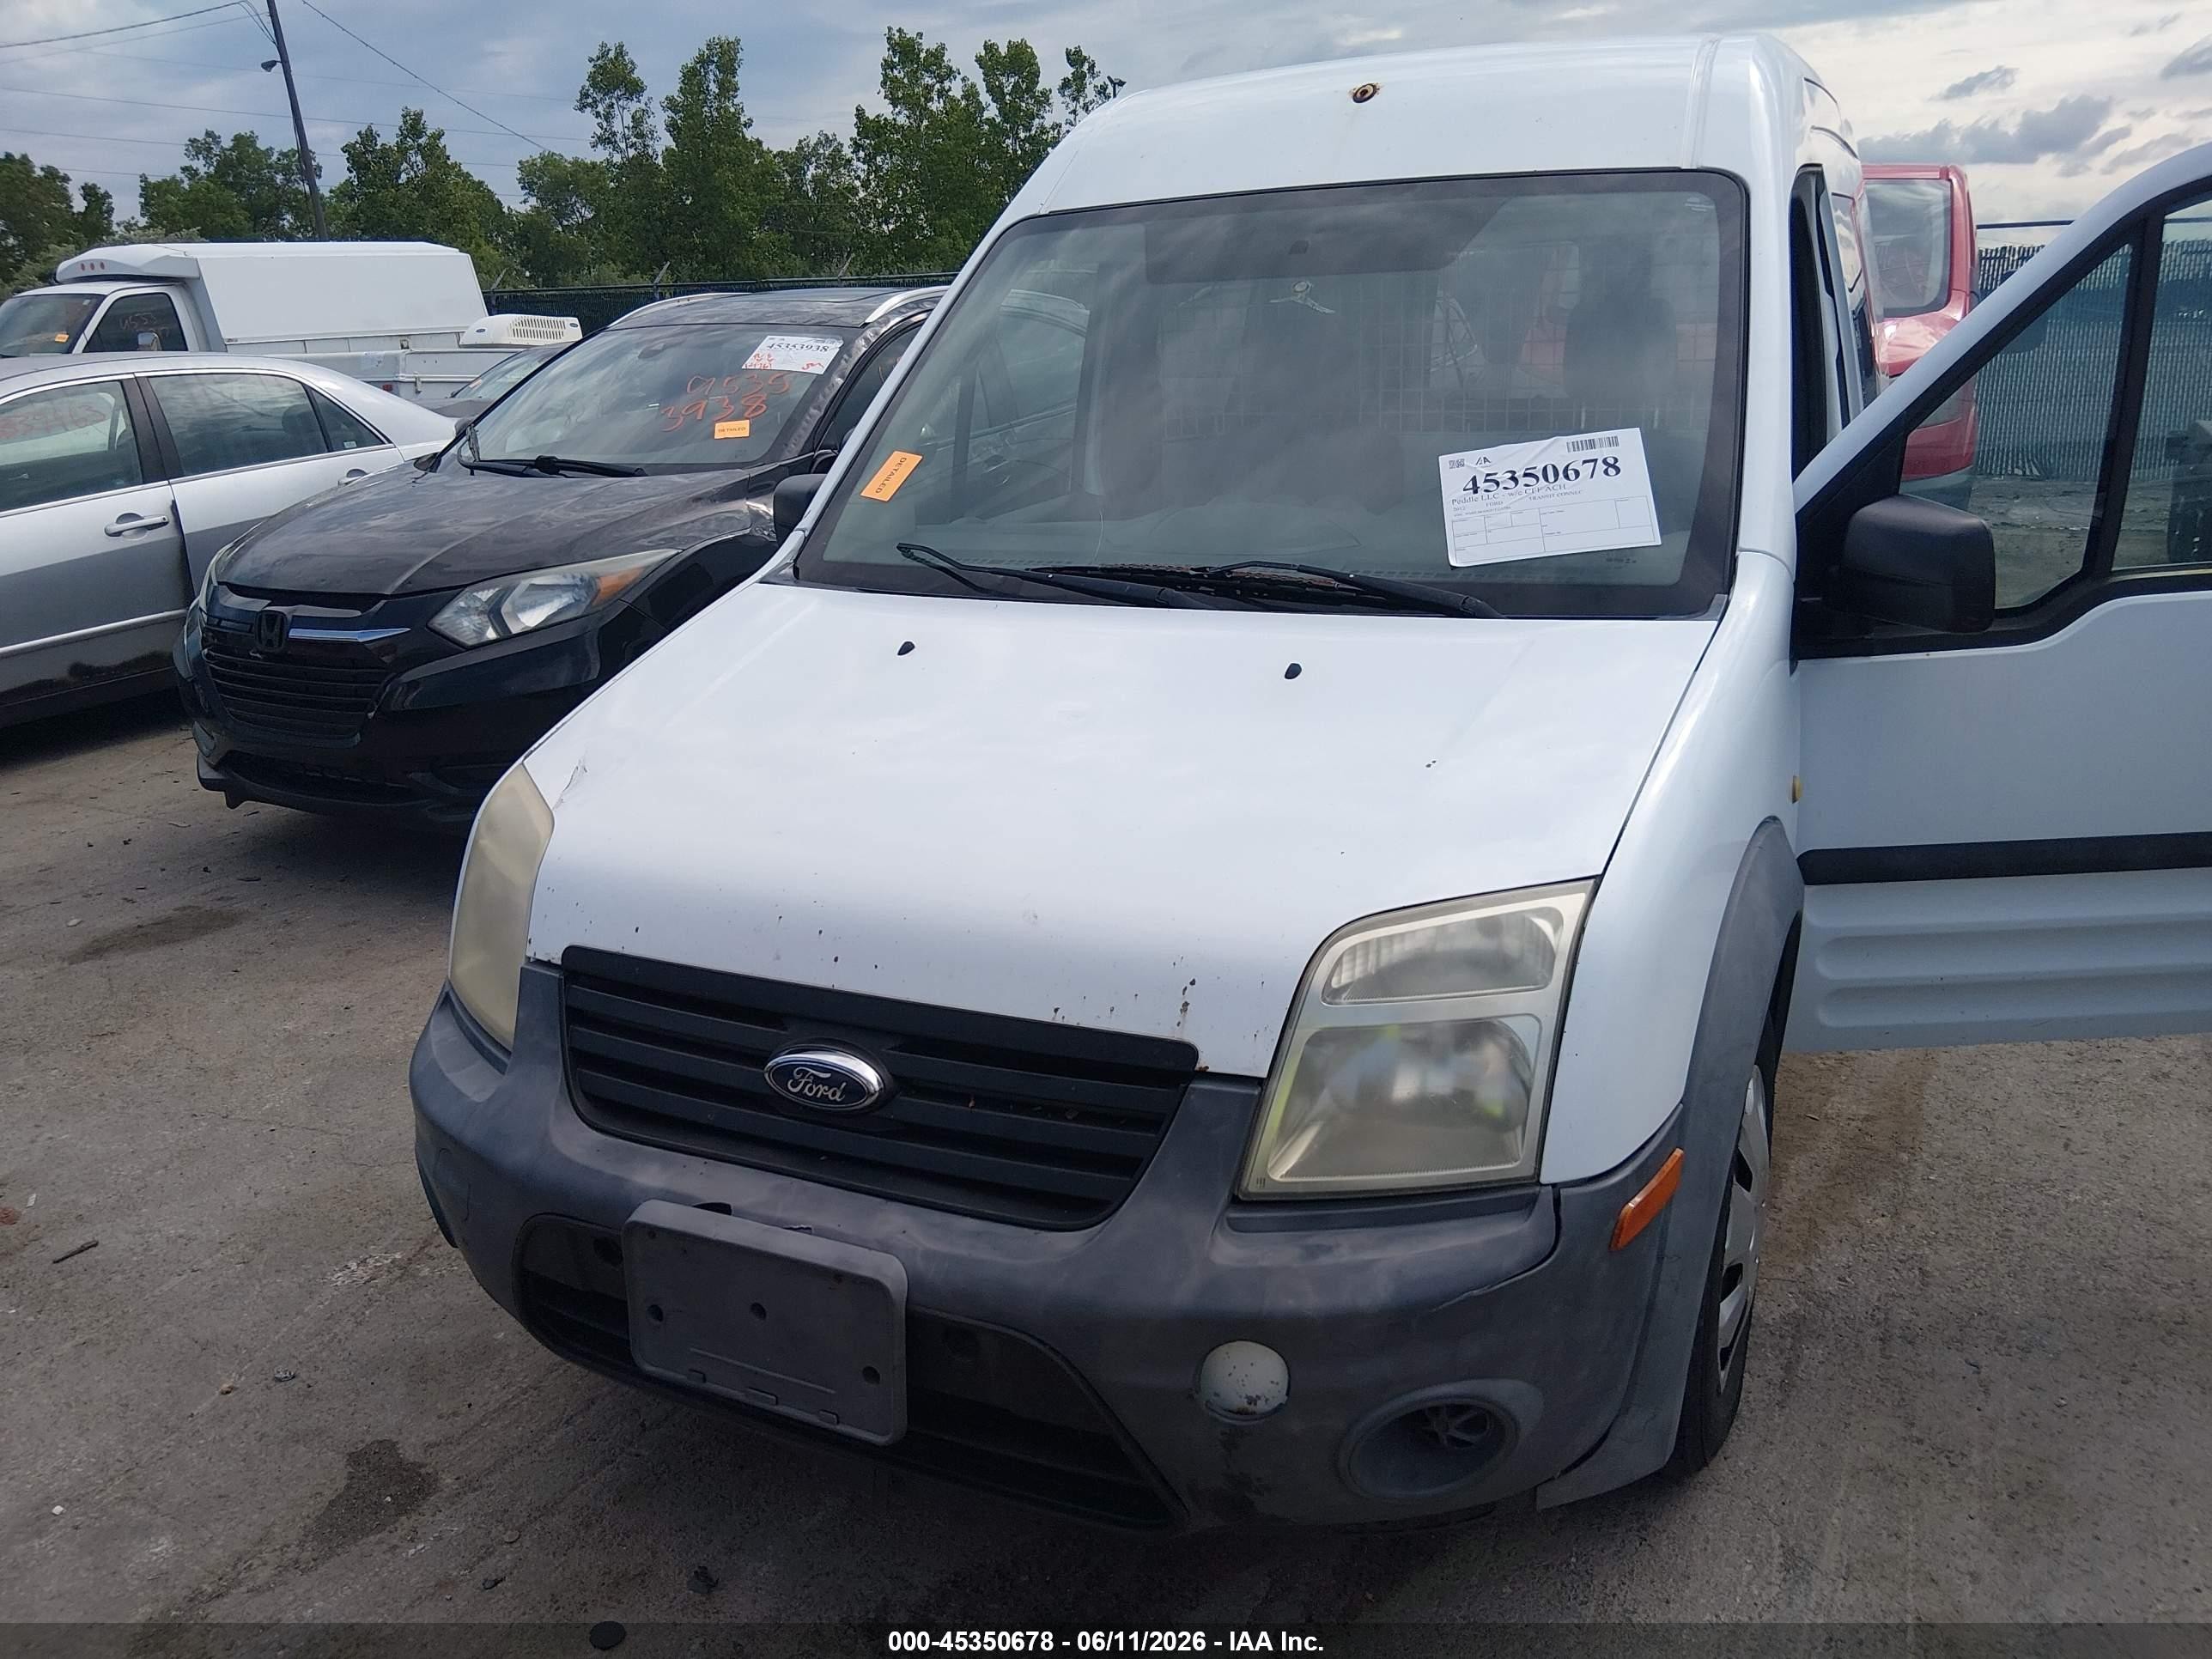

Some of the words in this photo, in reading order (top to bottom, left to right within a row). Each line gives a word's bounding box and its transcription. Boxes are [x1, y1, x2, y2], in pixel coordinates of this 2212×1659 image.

[875, 456, 908, 494] DETAILED
[1462, 455, 1621, 495] 45350678
[1451, 495, 1479, 505] Peddle
[1481, 493, 1499, 501] LLC
[787, 1066, 847, 1102] Ford
